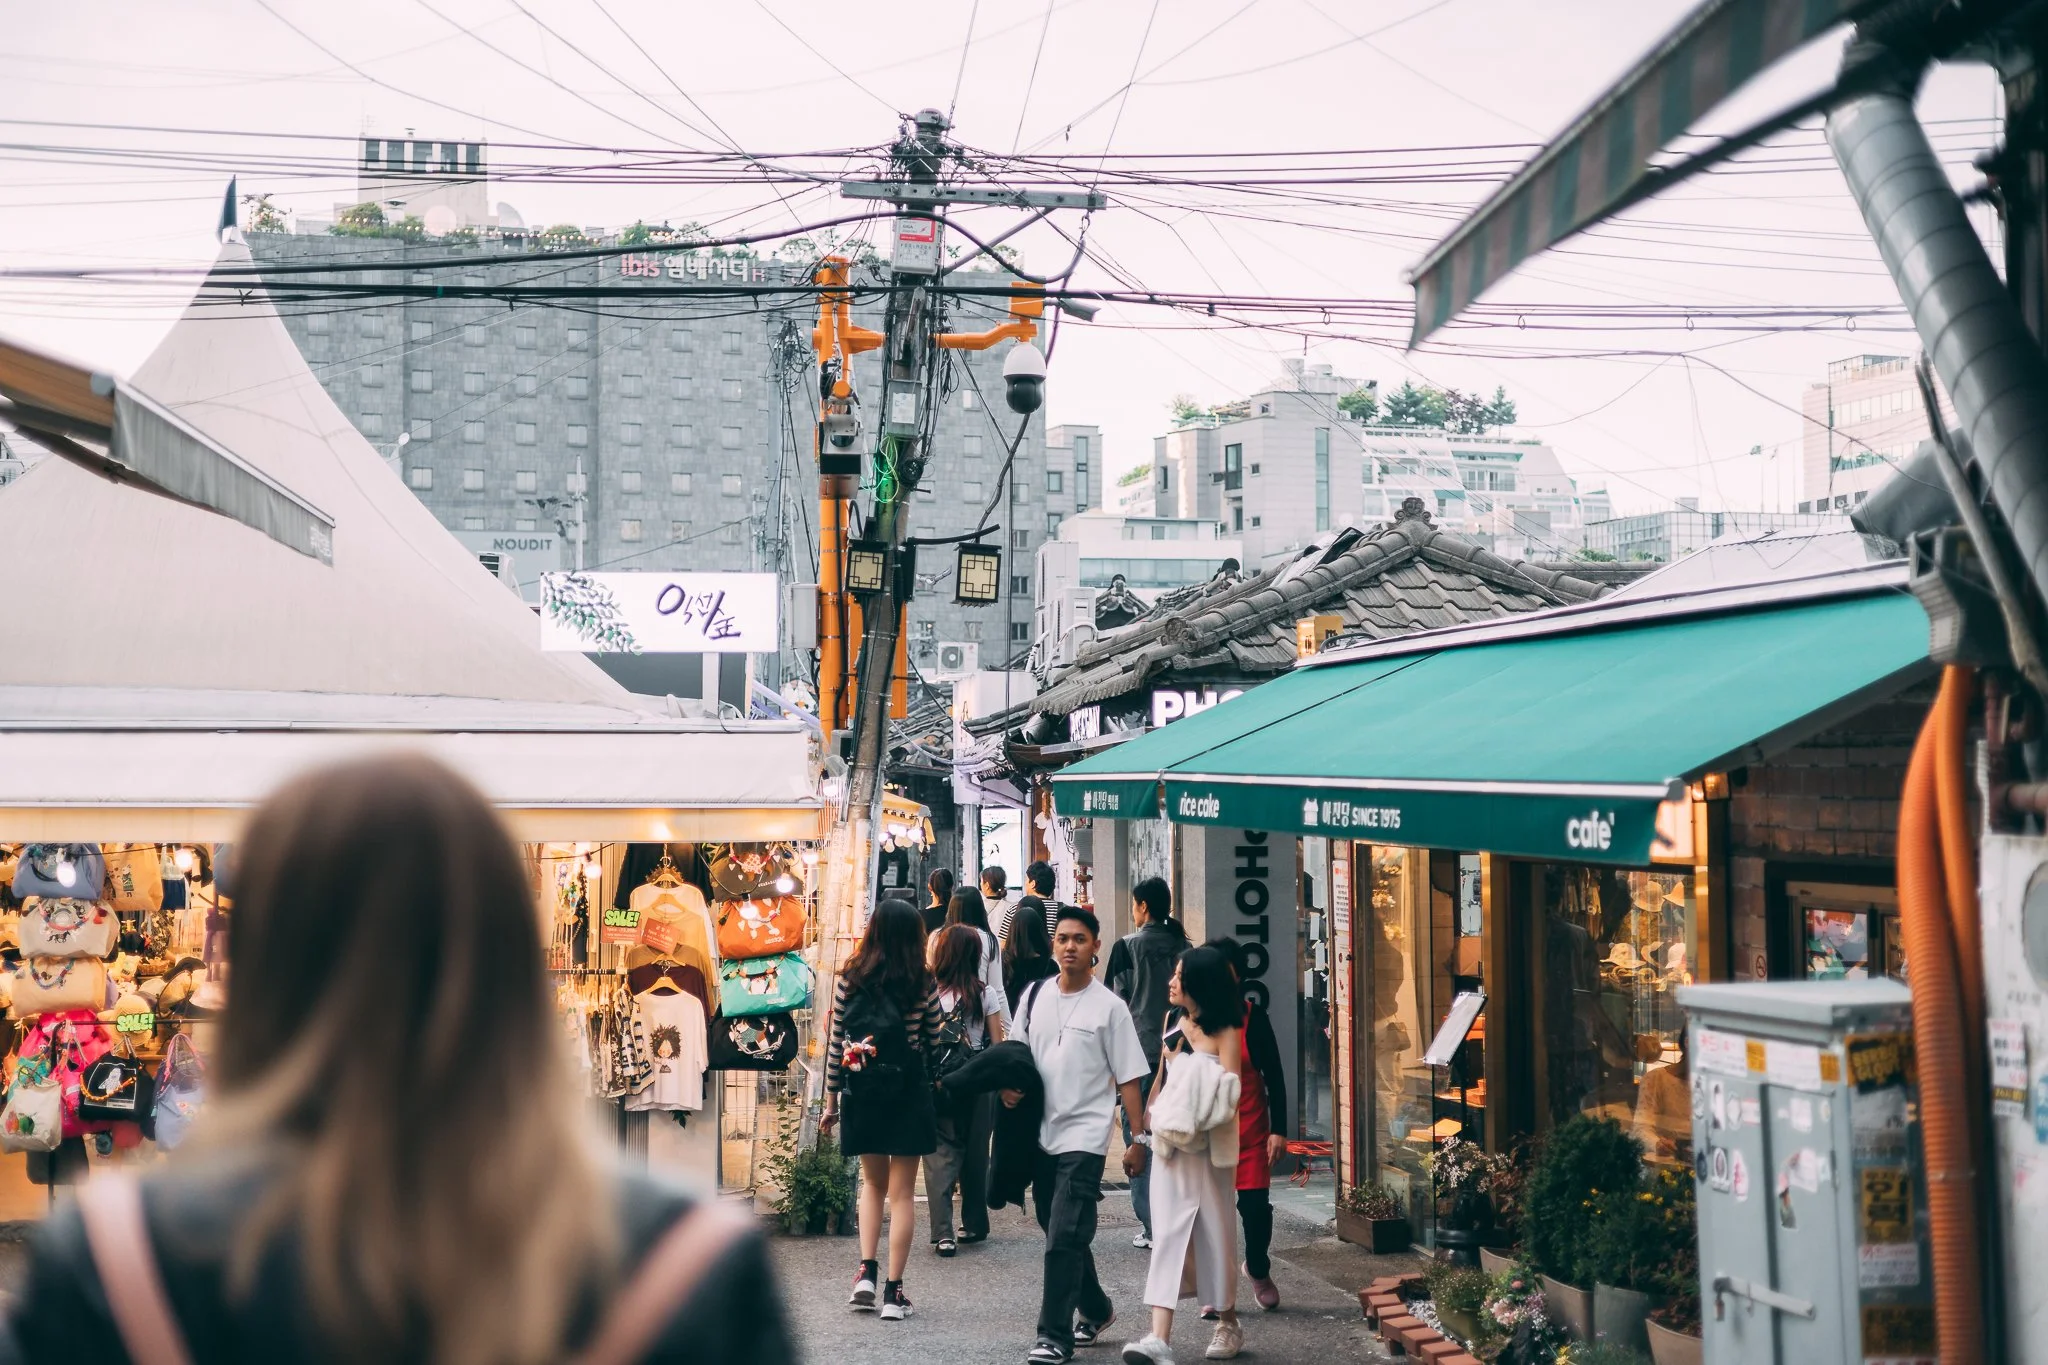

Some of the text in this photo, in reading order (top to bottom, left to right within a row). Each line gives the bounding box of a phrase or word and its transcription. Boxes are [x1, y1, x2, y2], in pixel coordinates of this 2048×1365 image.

[621, 254, 660, 277] ibis
[493, 538, 552, 550] NOUDIT
[1179, 792, 1220, 818] rice cake
[1351, 807, 1378, 827] SINCE
[1379, 808, 1401, 829] 1975
[604, 909, 641, 928] SALE!
[117, 1012, 154, 1032] SALE!
